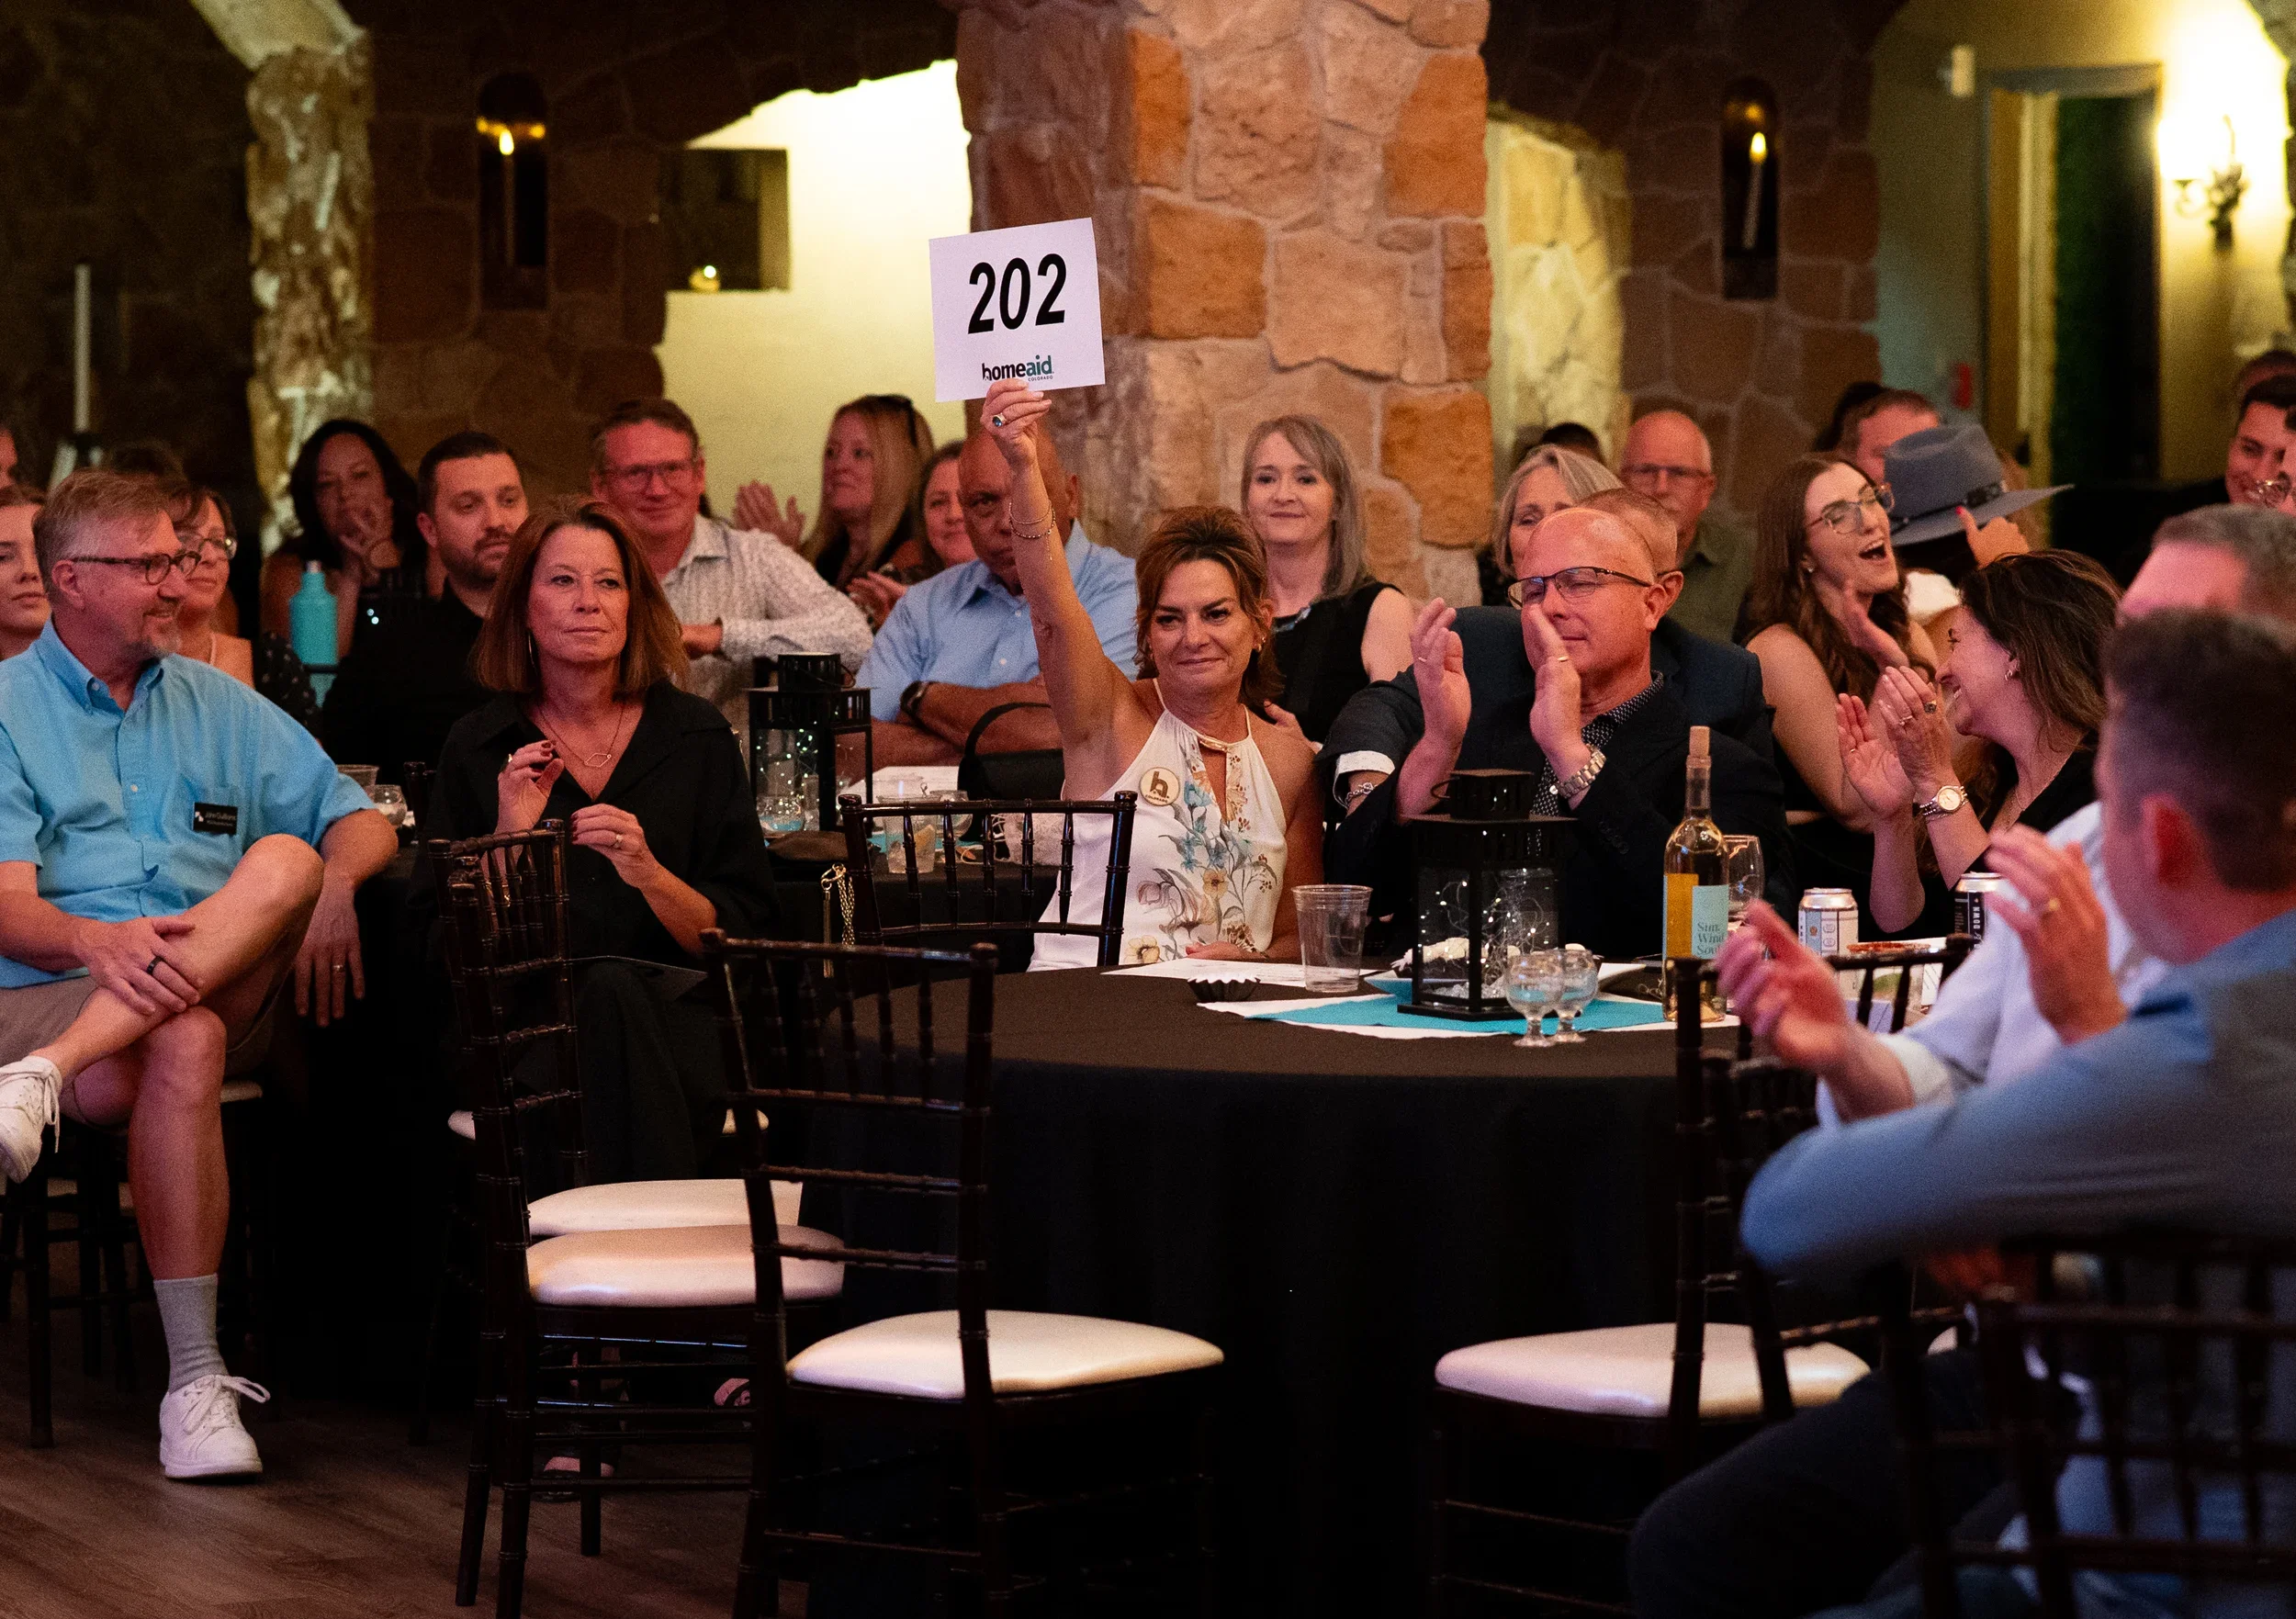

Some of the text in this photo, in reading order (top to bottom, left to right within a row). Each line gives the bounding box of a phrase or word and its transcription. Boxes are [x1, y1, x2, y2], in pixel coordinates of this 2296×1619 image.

[968, 253, 1066, 334] 202
[982, 354, 1052, 381] homeaid
[1145, 794, 1168, 804] COLORADO
